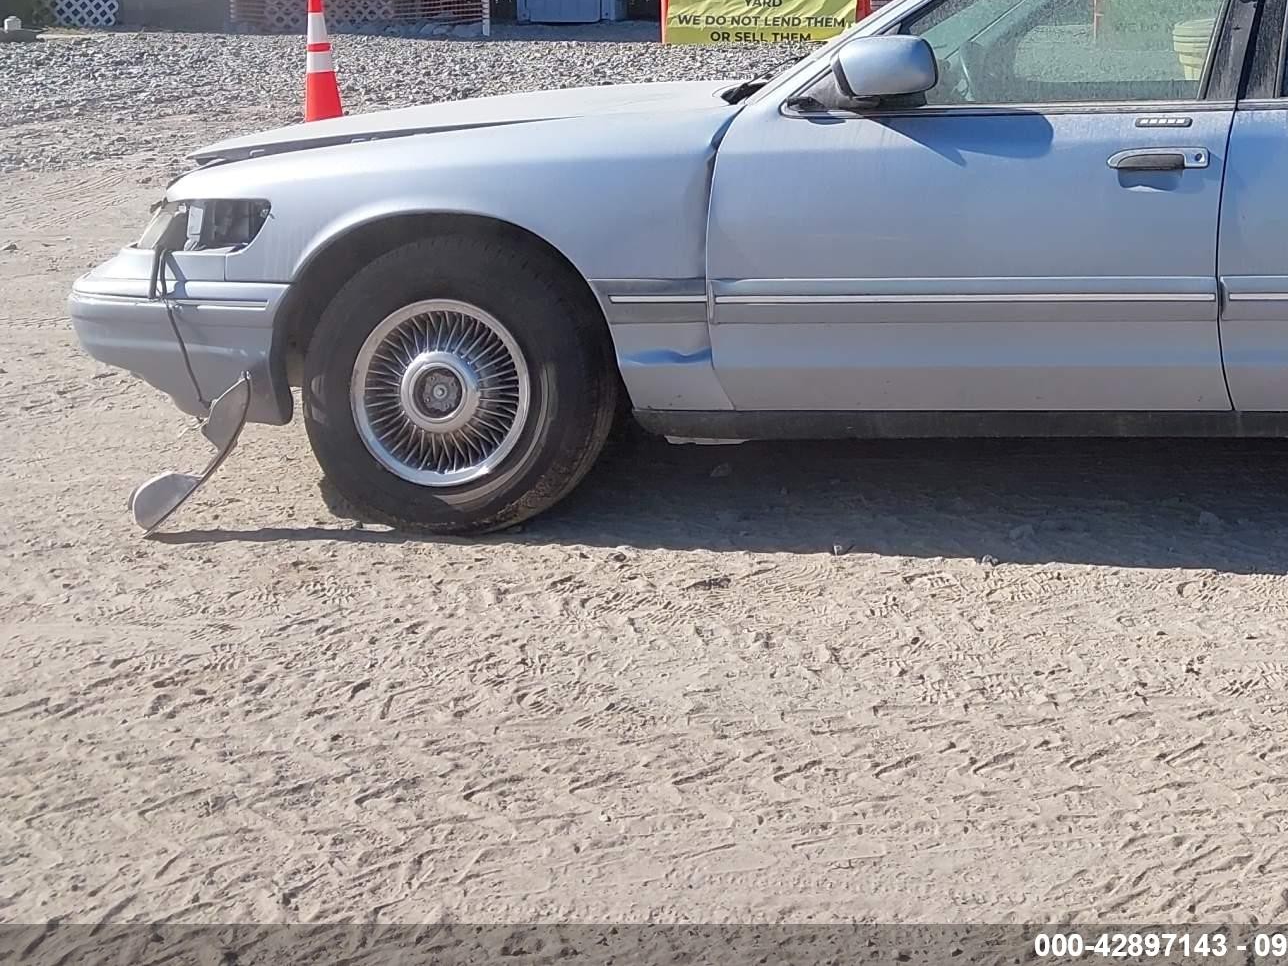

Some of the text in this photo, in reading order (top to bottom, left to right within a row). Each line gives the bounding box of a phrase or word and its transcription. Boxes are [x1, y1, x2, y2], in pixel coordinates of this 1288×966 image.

[678, 15, 845, 28] WE DO NOT LEND THEM
[710, 31, 812, 43] OR SELL THEM
